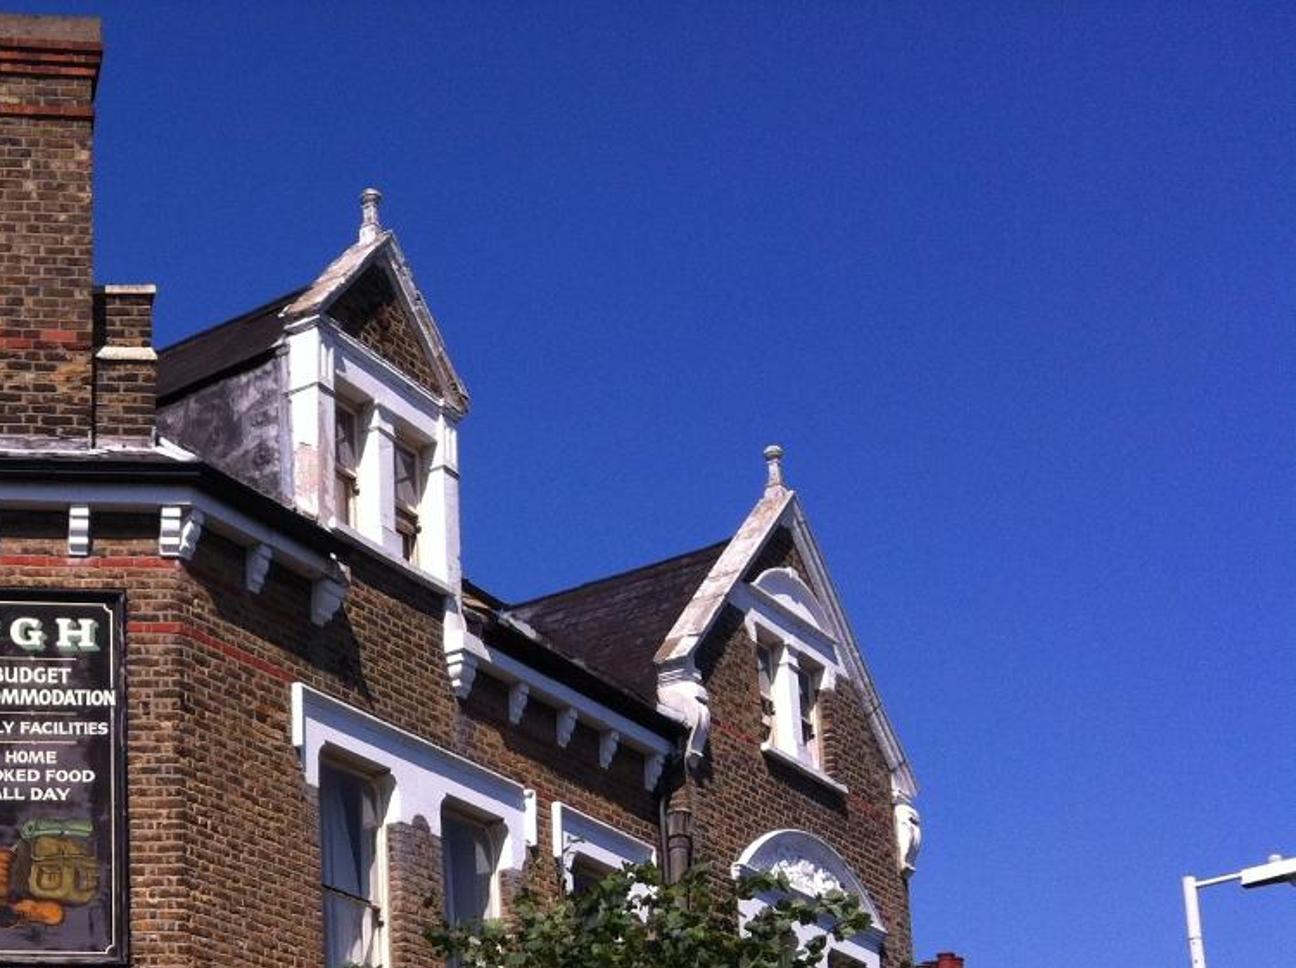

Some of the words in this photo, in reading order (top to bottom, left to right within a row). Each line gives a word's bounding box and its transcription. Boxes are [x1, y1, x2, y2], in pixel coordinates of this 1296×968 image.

[19, 720, 109, 736] FACILITIES
[4, 751, 58, 765] HOME
[45, 769, 96, 783] FOOD
[30, 787, 71, 802] DAY
